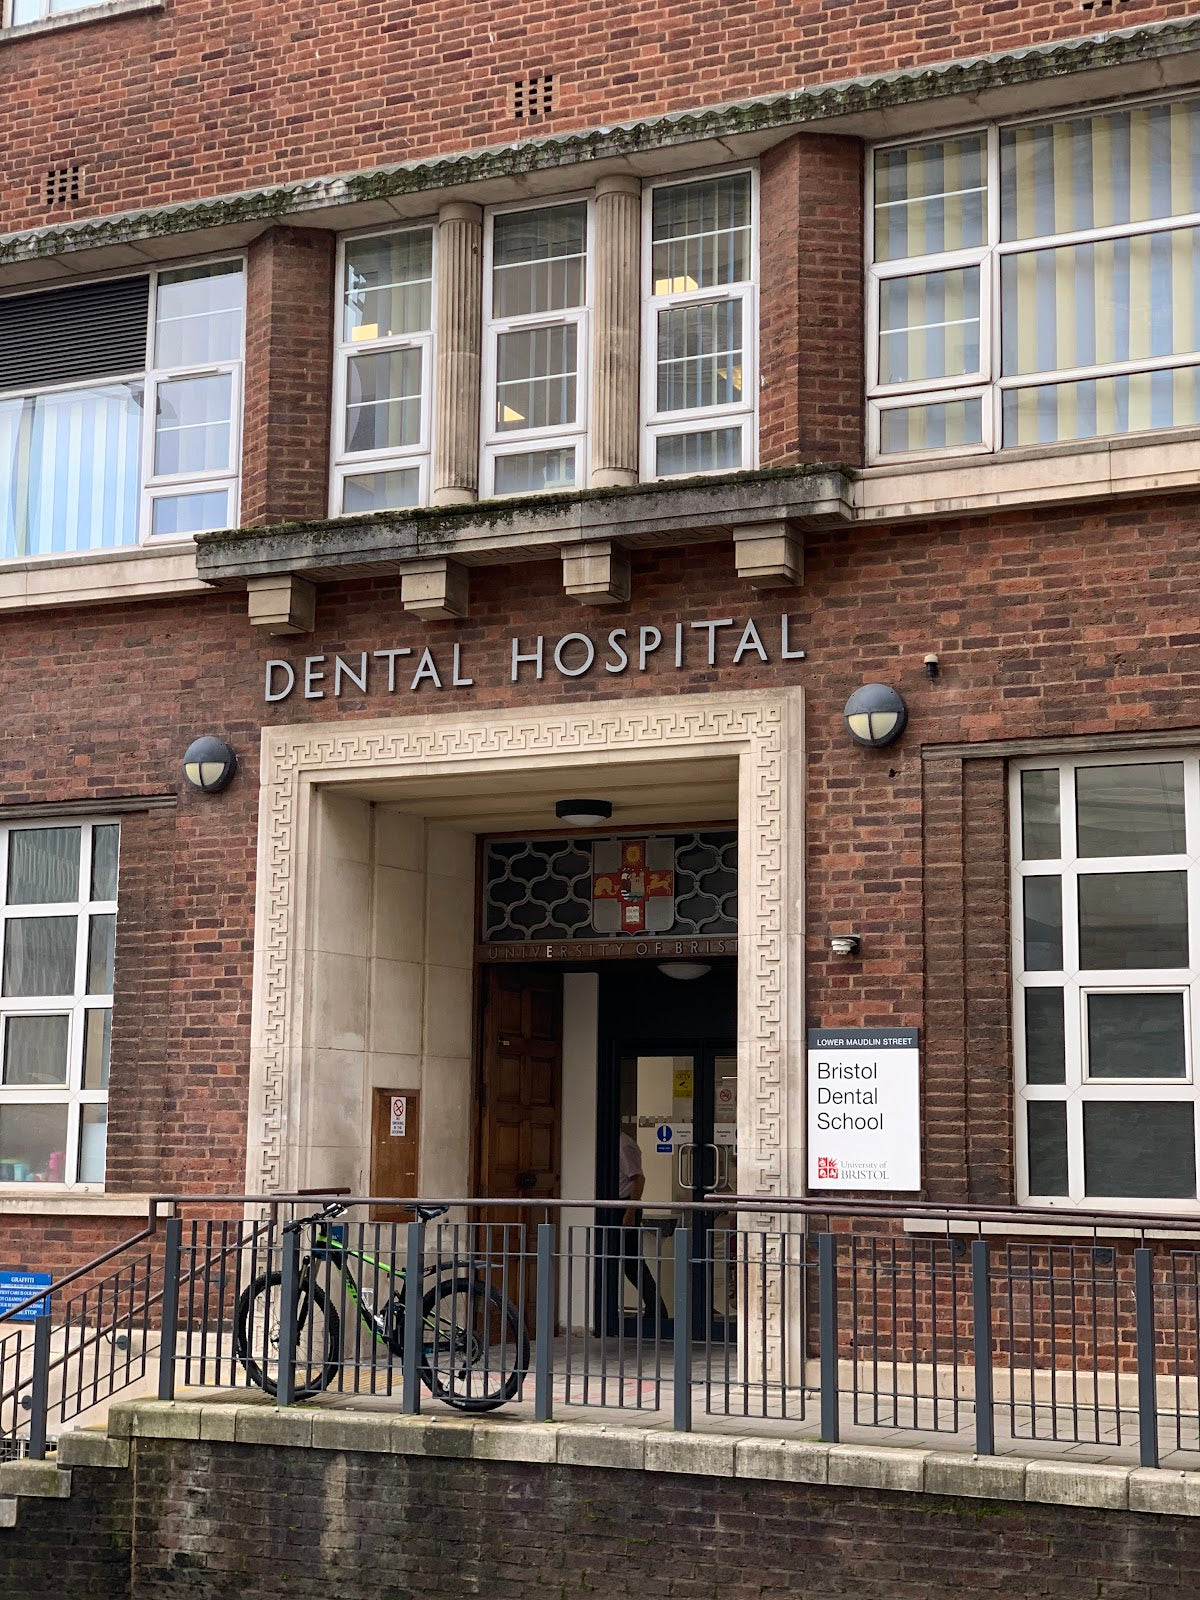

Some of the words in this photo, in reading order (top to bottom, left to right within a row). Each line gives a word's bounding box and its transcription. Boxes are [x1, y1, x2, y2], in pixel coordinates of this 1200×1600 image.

[264, 643, 473, 702] DENTAL
[511, 613, 805, 681] HOSPITAL
[488, 943, 623, 959] UNIVERSITY
[636, 942, 663, 956] OF
[846, 1038, 881, 1046] MAUDLIN
[883, 1037, 913, 1045] STREET
[817, 1062, 878, 1080] Bristol
[817, 1087, 878, 1105] Dental
[817, 1112, 884, 1130] School
[840, 1160, 878, 1170] University
[879, 1160, 888, 1169] of
[841, 1169, 890, 1180] BRISTOL
